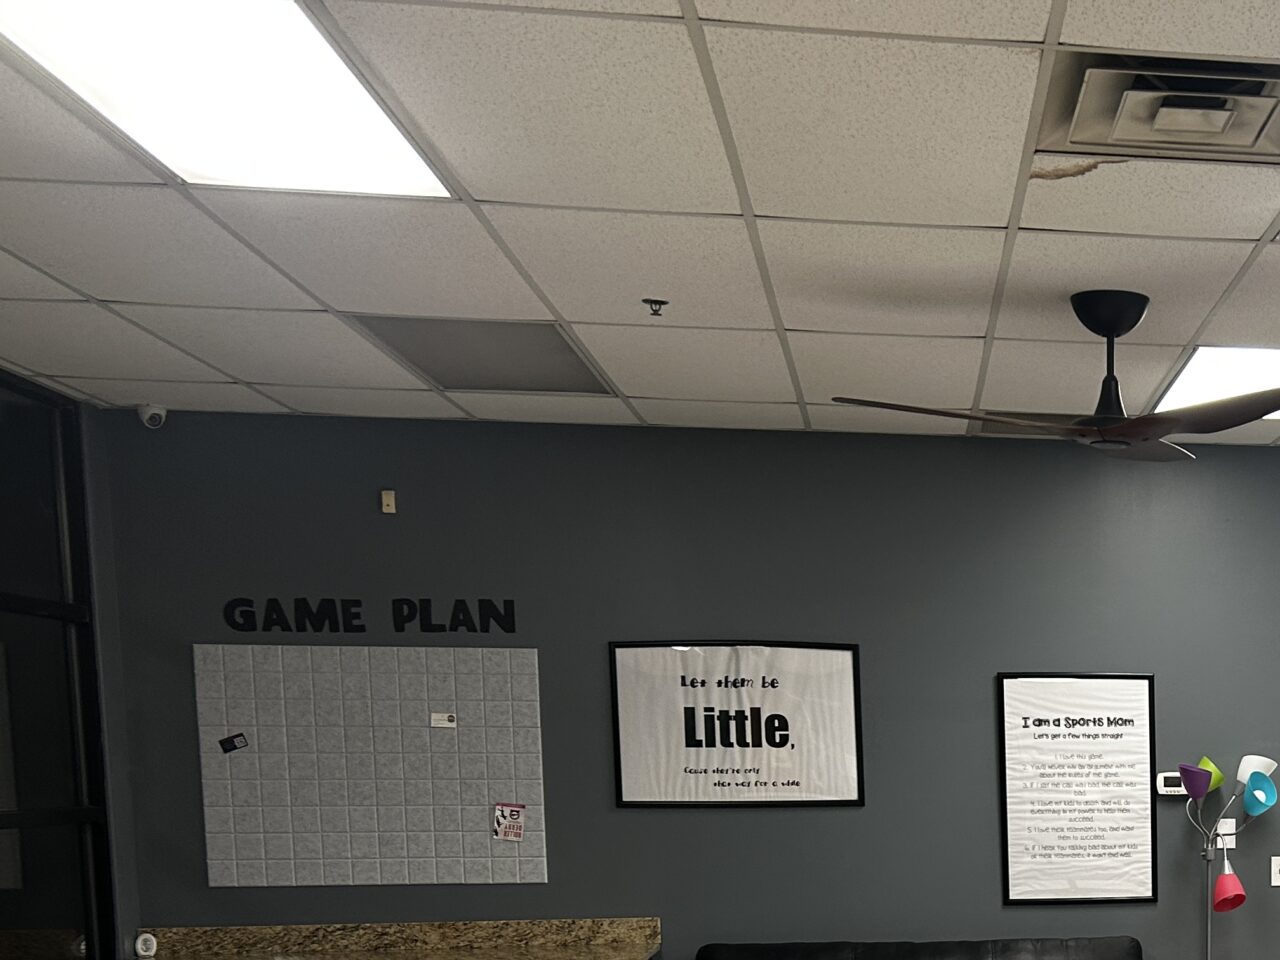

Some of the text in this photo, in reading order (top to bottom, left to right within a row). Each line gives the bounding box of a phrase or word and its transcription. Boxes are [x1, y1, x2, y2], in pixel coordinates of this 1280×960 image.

[223, 597, 516, 633] GAME PLAN
[681, 675, 780, 689] Let them be
[683, 706, 795, 750] Little,
[1022, 717, 1134, 729] I am a Sports Mom
